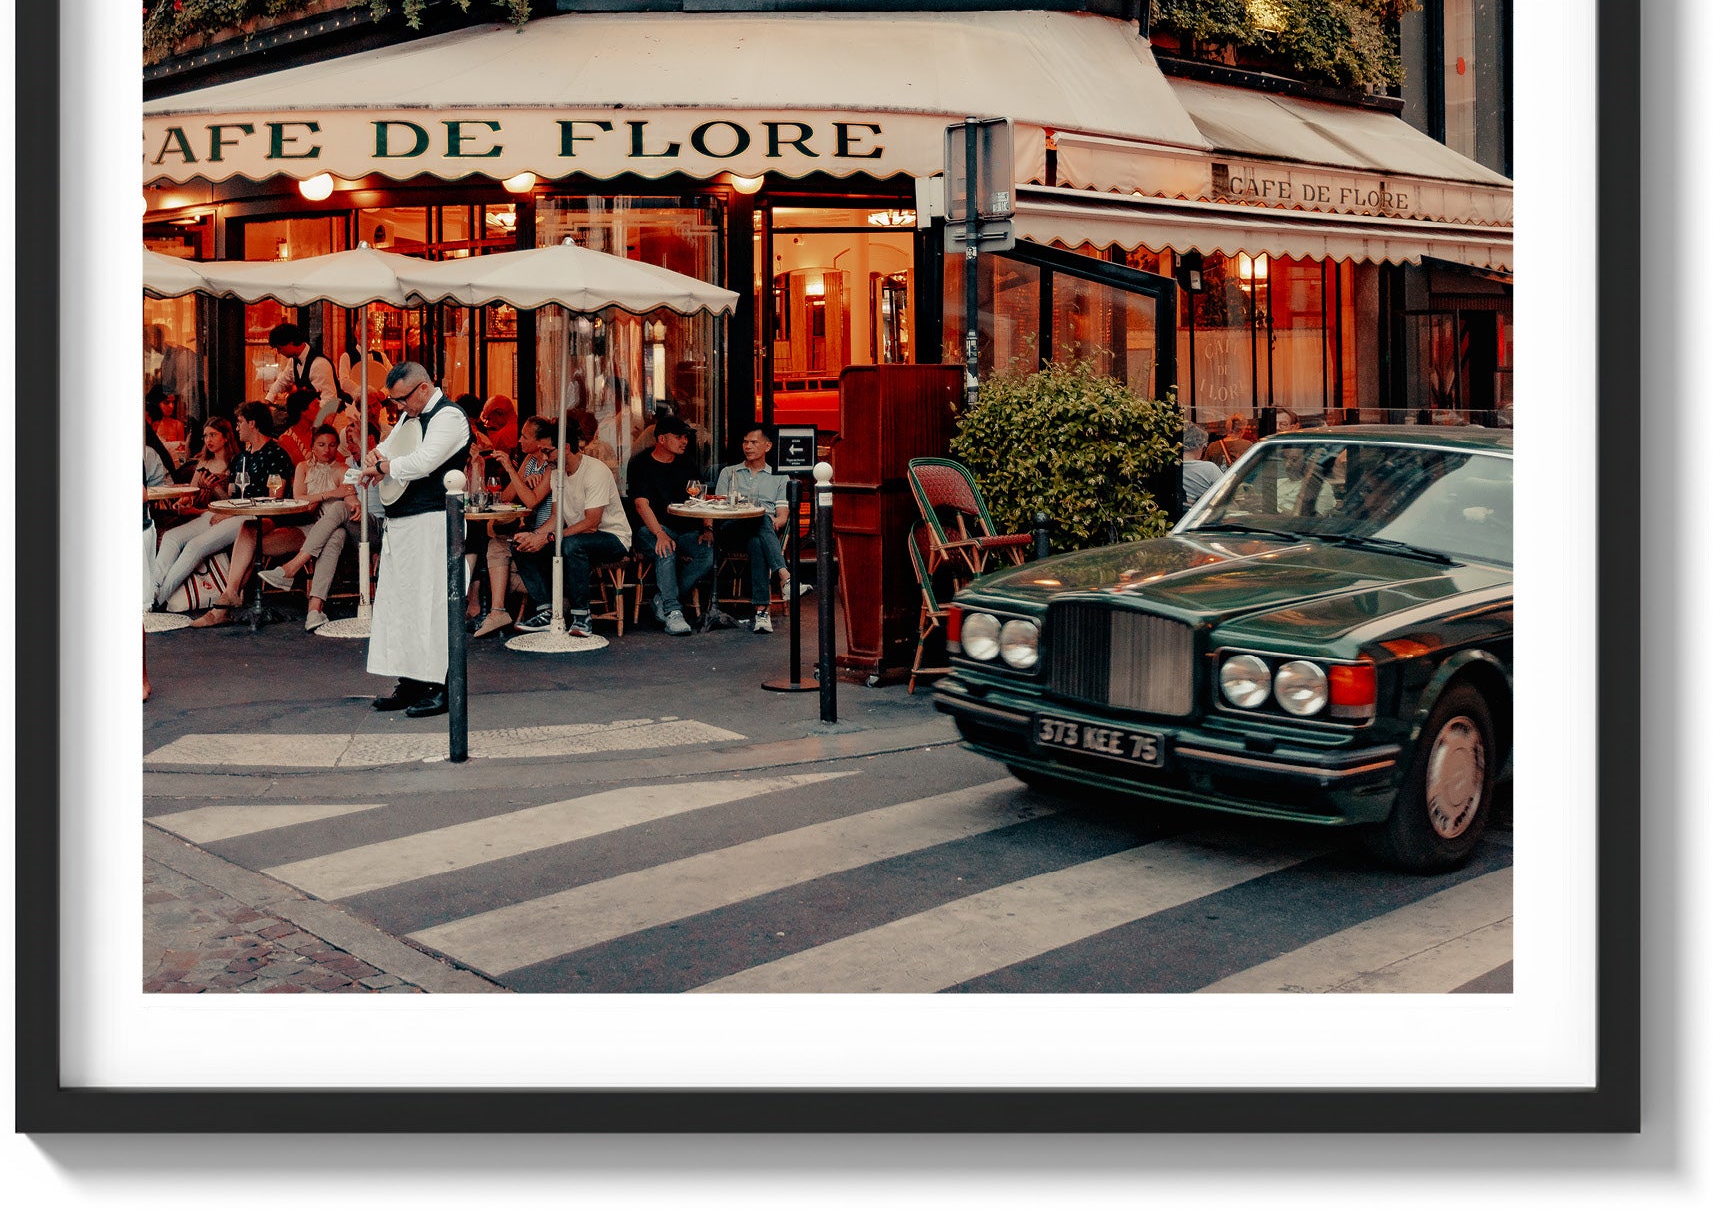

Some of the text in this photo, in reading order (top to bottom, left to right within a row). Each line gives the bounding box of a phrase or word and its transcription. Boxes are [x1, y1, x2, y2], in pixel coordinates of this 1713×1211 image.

[143, 119, 885, 166] AFE DE FLORE
[1229, 176, 1410, 210] CAFE DE FLORE
[1039, 718, 1078, 746] 373
[1129, 734, 1157, 761] 75
